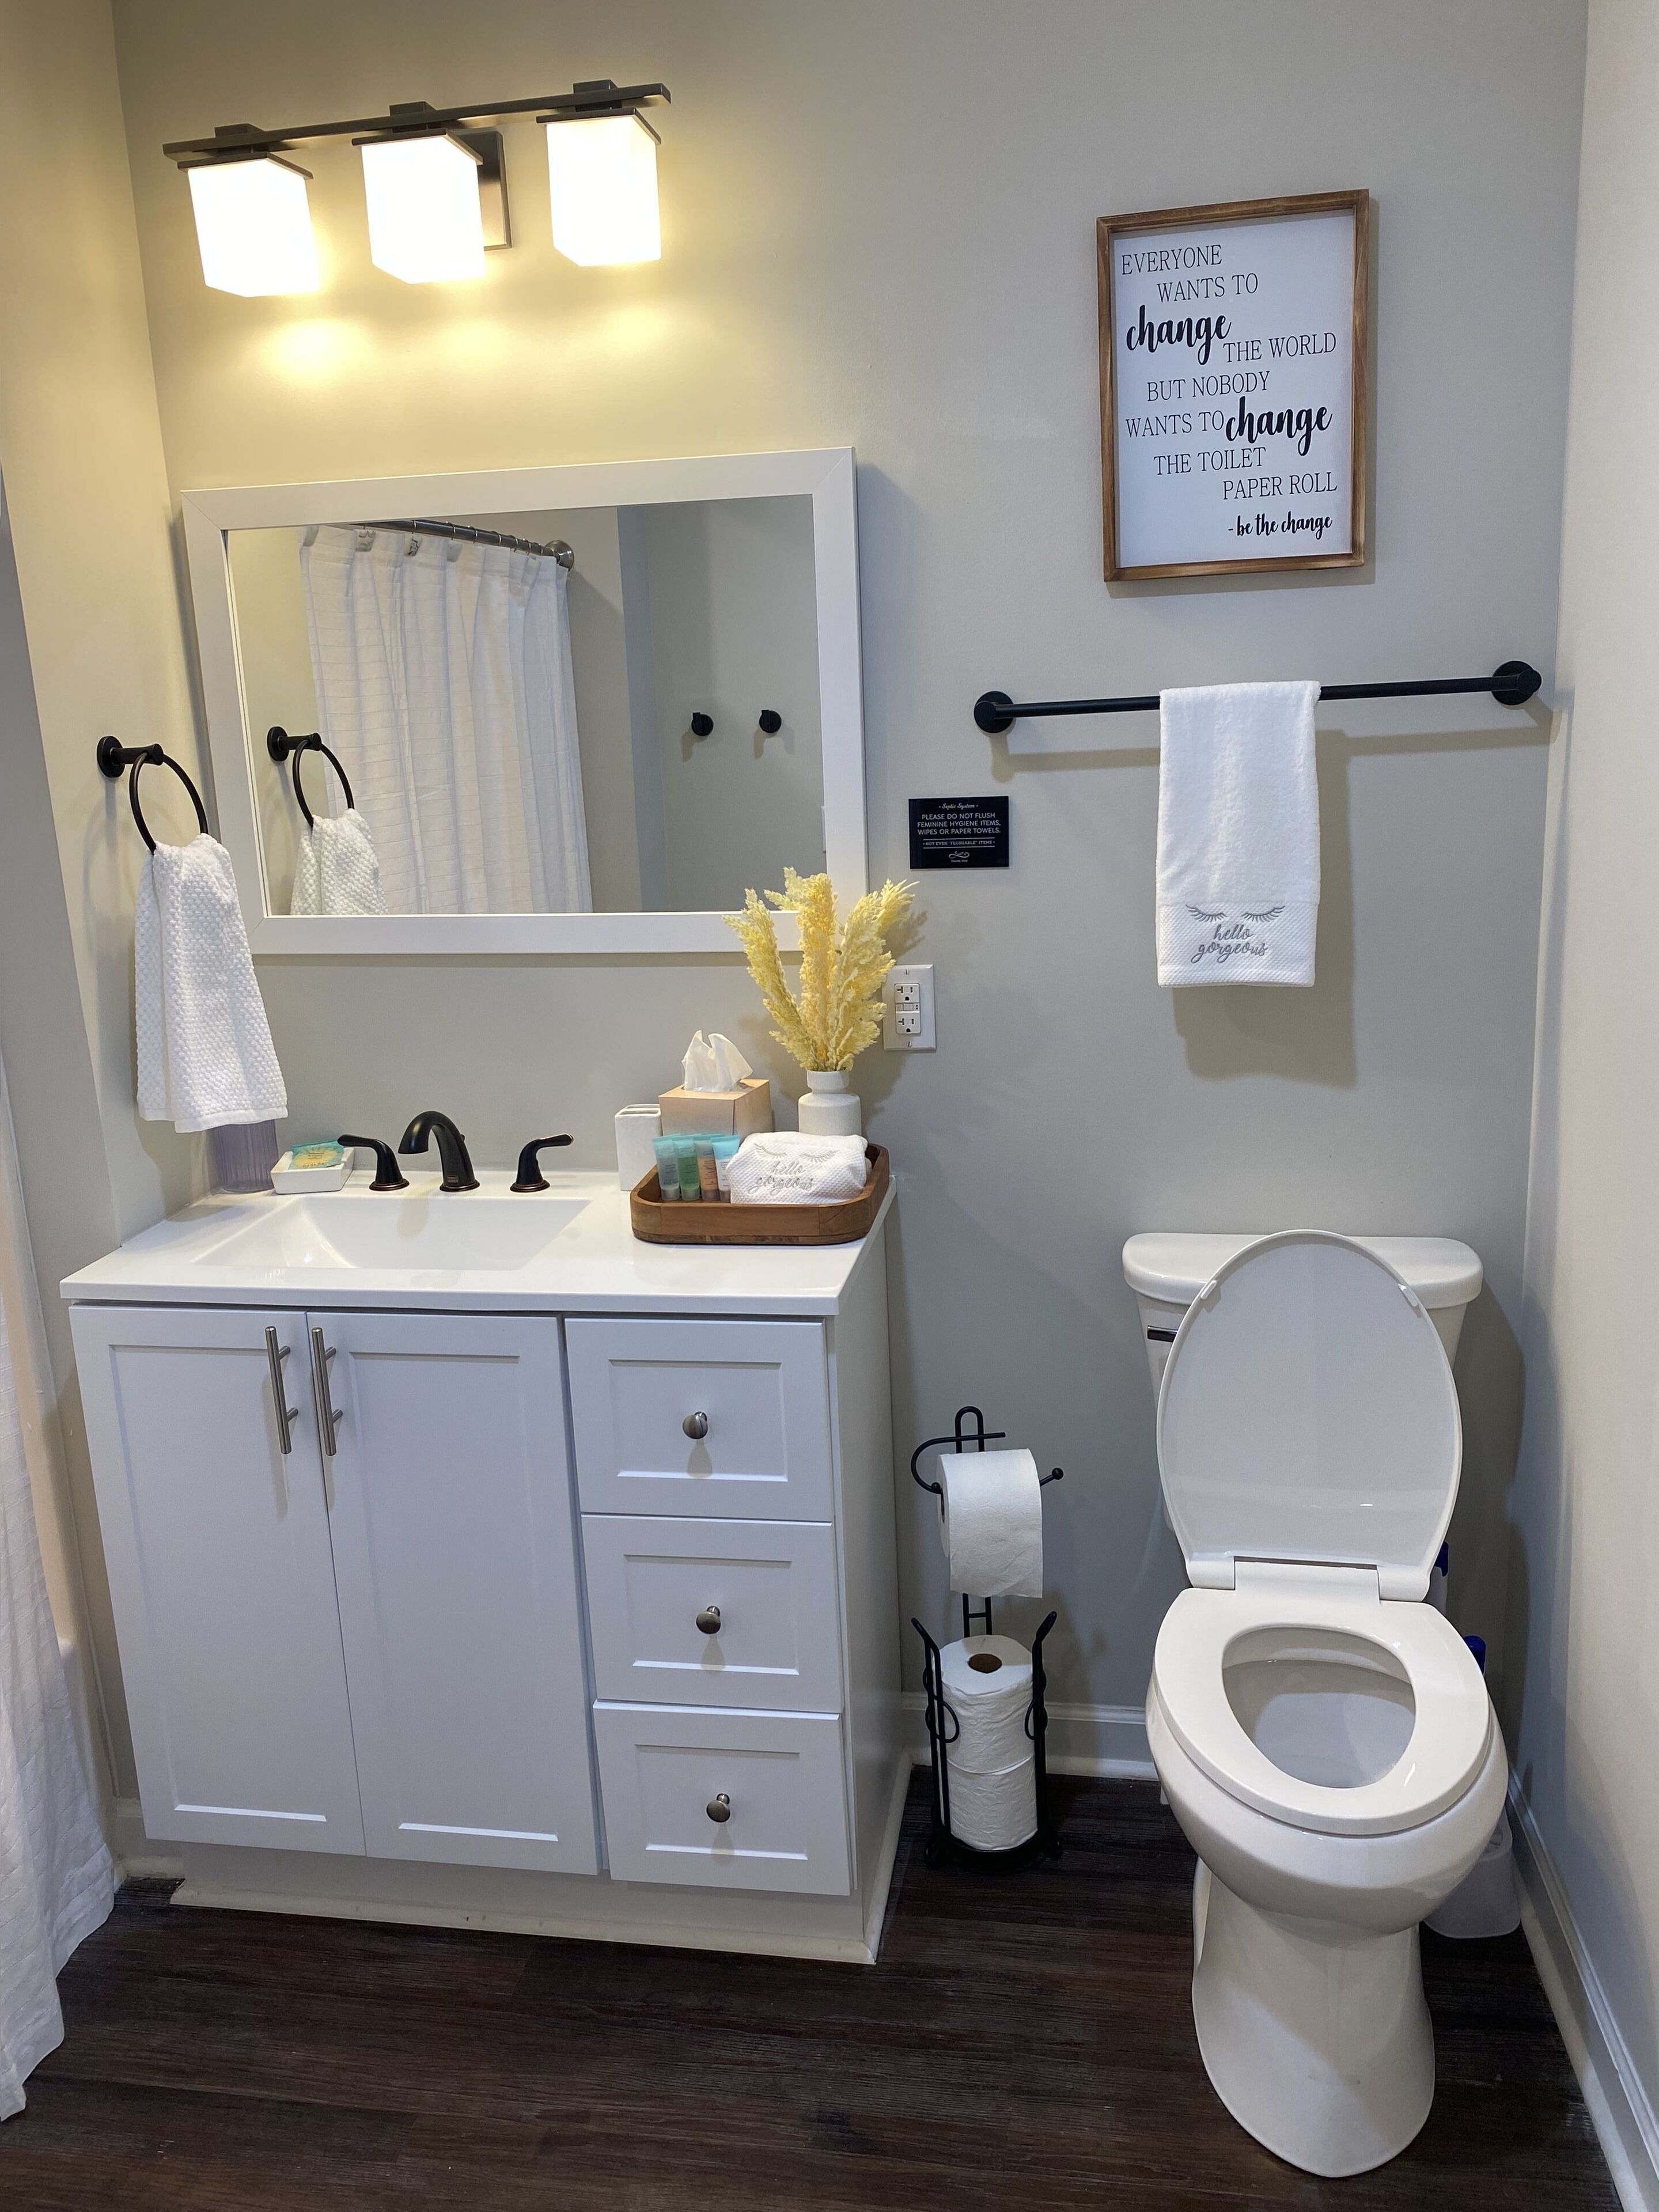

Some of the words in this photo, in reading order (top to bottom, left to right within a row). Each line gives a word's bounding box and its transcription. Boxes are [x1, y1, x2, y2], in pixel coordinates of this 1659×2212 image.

[1121, 244, 1222, 275] EVERYONE
[1157, 276, 1225, 302] WANTS
[1232, 272, 1258, 295] TO
[1126, 305, 1232, 365] change
[1223, 339, 1262, 363] THE
[1269, 332, 1336, 358] WORLD
[1147, 378, 1185, 402] BUT
[1192, 370, 1270, 397] NOBODY
[1126, 413, 1192, 438] WANTS
[1199, 410, 1224, 432] TO
[1225, 396, 1333, 457] change
[1153, 453, 1192, 475] THE
[1197, 446, 1266, 471] TOILET
[1223, 476, 1283, 500] PAPER
[1289, 472, 1338, 494] ROLL
[1255, 513, 1278, 536] the
[1281, 510, 1333, 540] change
[957, 802, 975, 810] System
[1213, 924, 1254, 941] hello
[1190, 942, 1268, 964] gorgeous
[772, 1161, 806, 1176] hello
[748, 1176, 814, 1196] gorgeous
